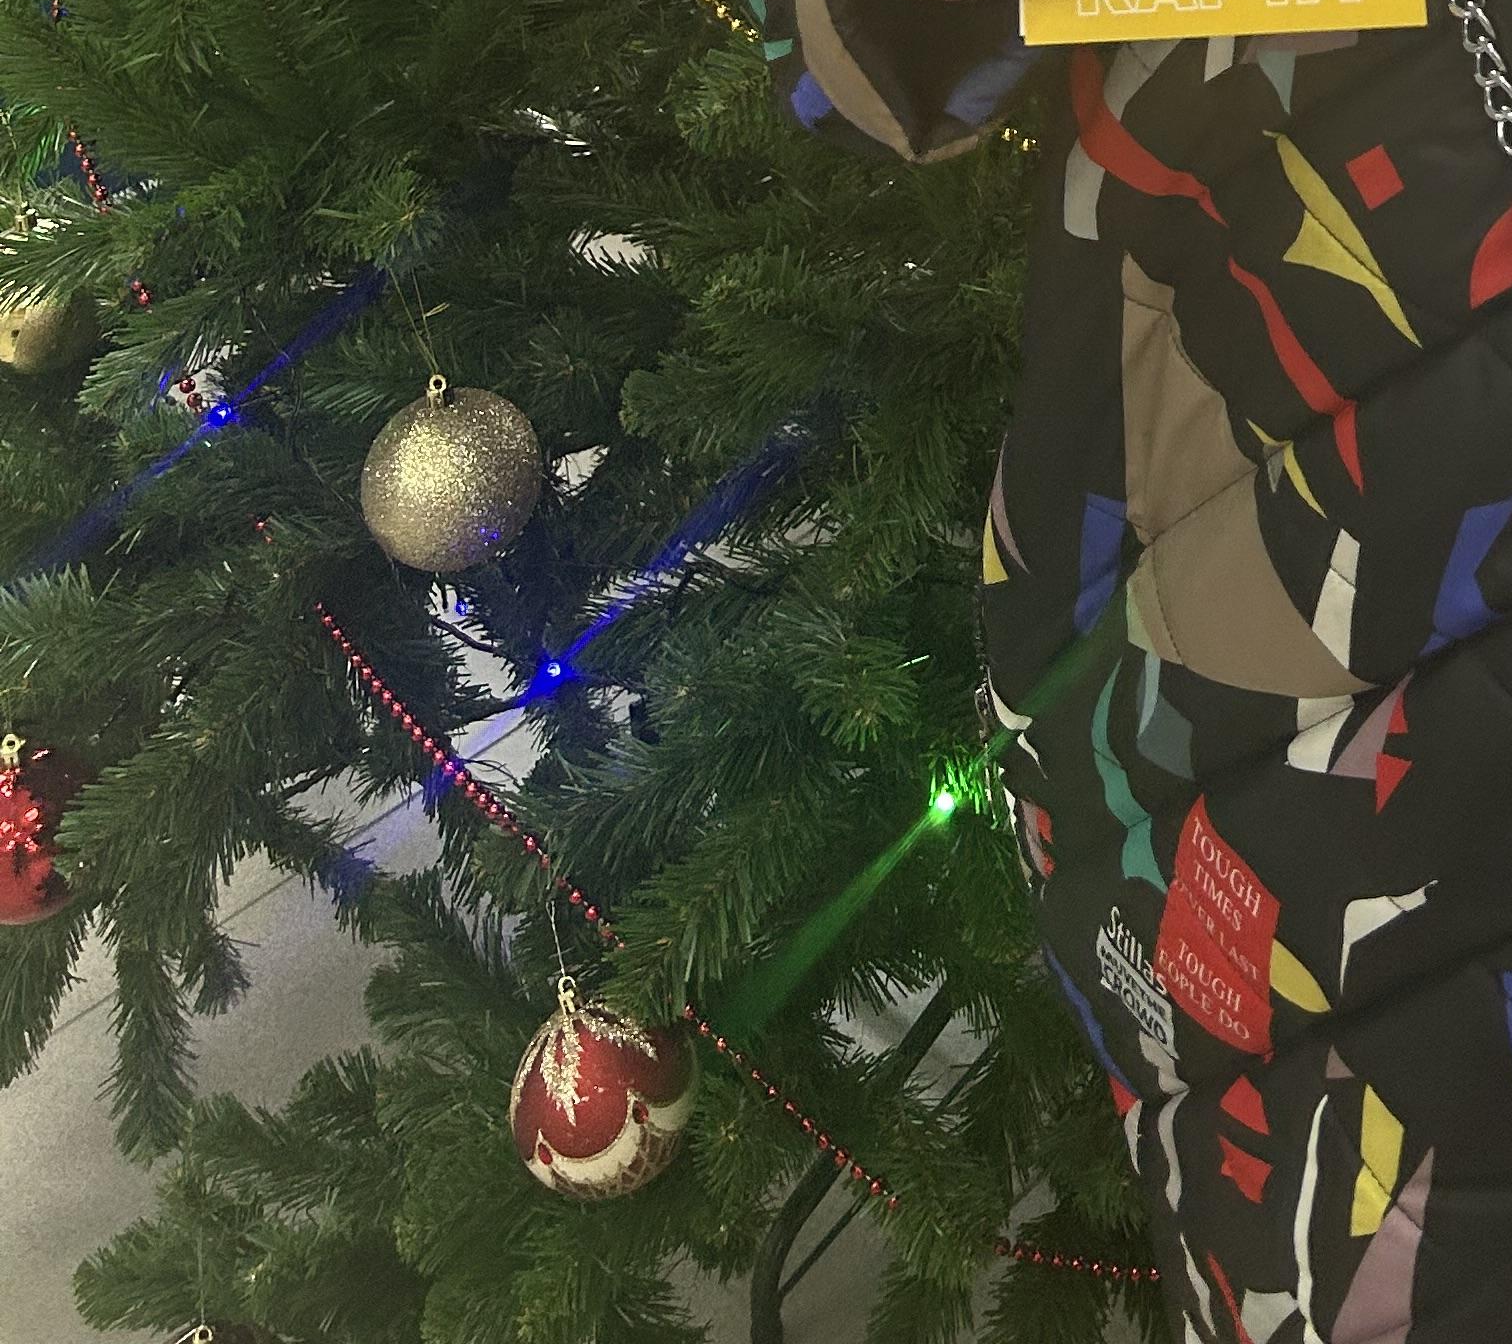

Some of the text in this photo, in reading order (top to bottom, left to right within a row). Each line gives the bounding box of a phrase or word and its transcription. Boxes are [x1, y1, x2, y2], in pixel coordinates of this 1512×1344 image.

[1191, 816, 1263, 919] TOUGH
[1193, 859, 1242, 933] TIMES
[1178, 937, 1242, 1013] TOUGH
[1217, 1007, 1251, 1041] DO
